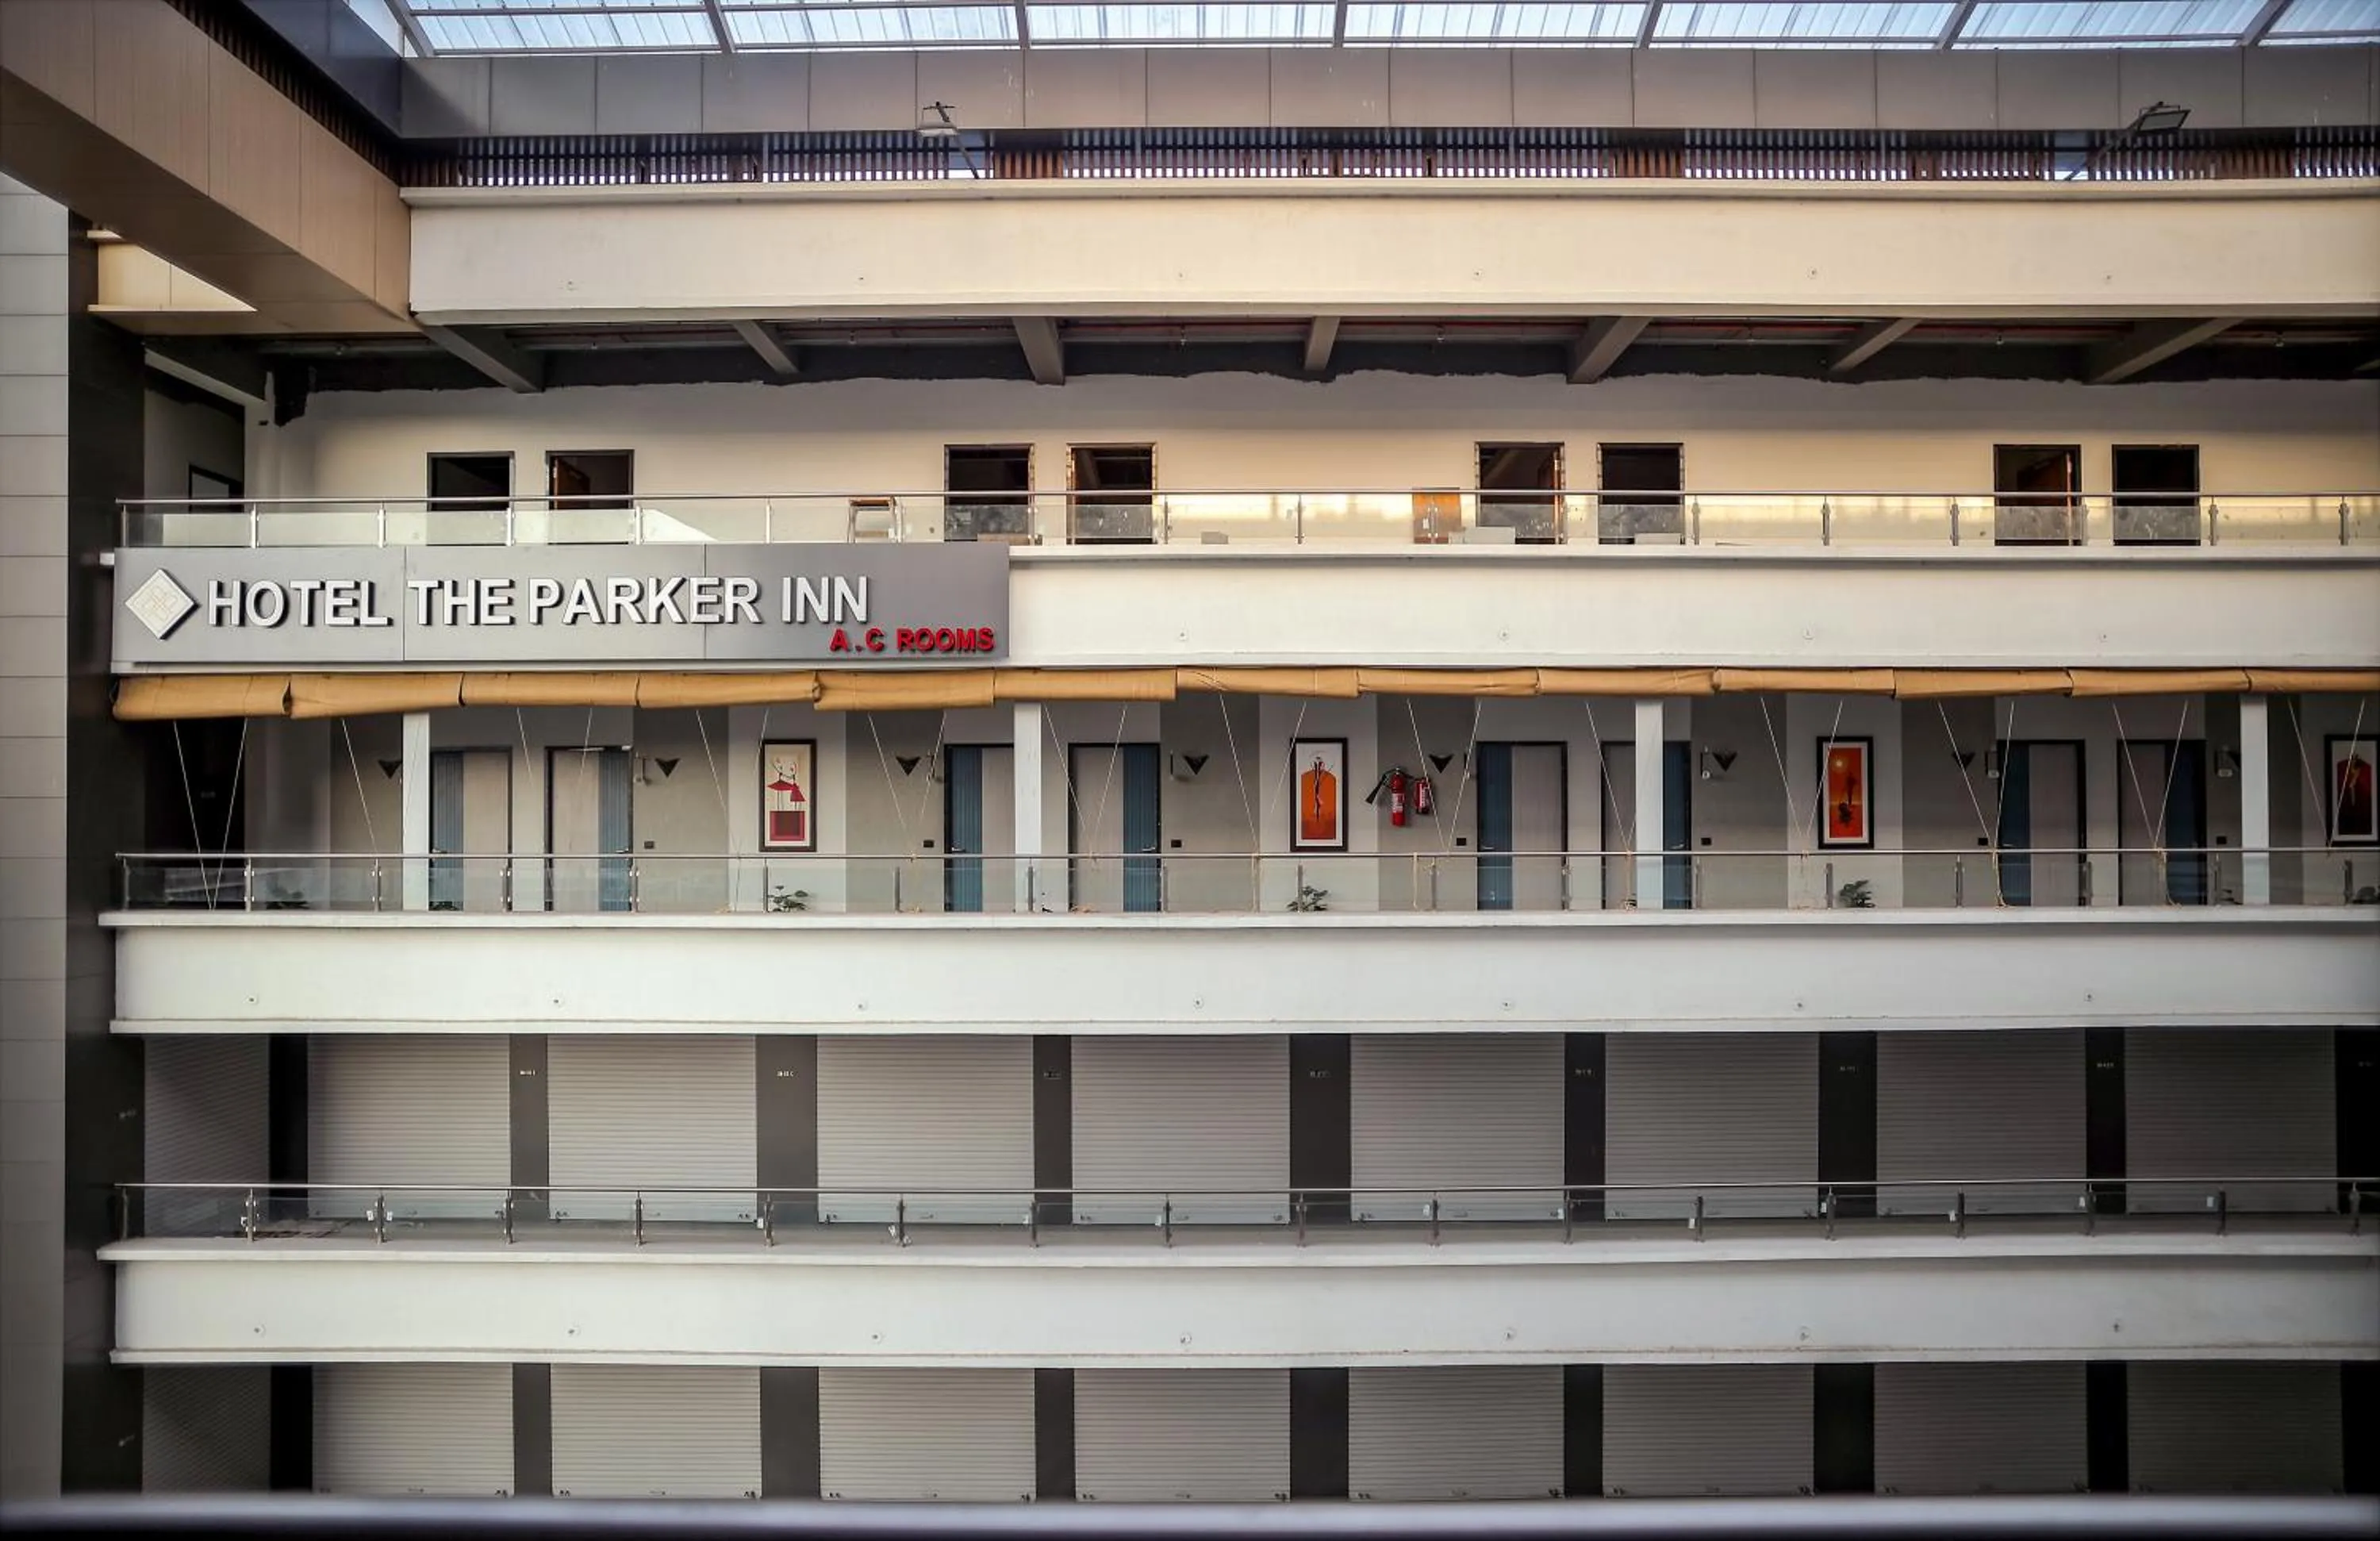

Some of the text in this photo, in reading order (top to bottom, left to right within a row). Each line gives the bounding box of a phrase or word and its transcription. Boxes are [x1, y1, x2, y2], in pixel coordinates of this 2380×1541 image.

[208, 575, 869, 627] HOTEL THE PARKER INN
[829, 627, 996, 653] A.C ROOMS
